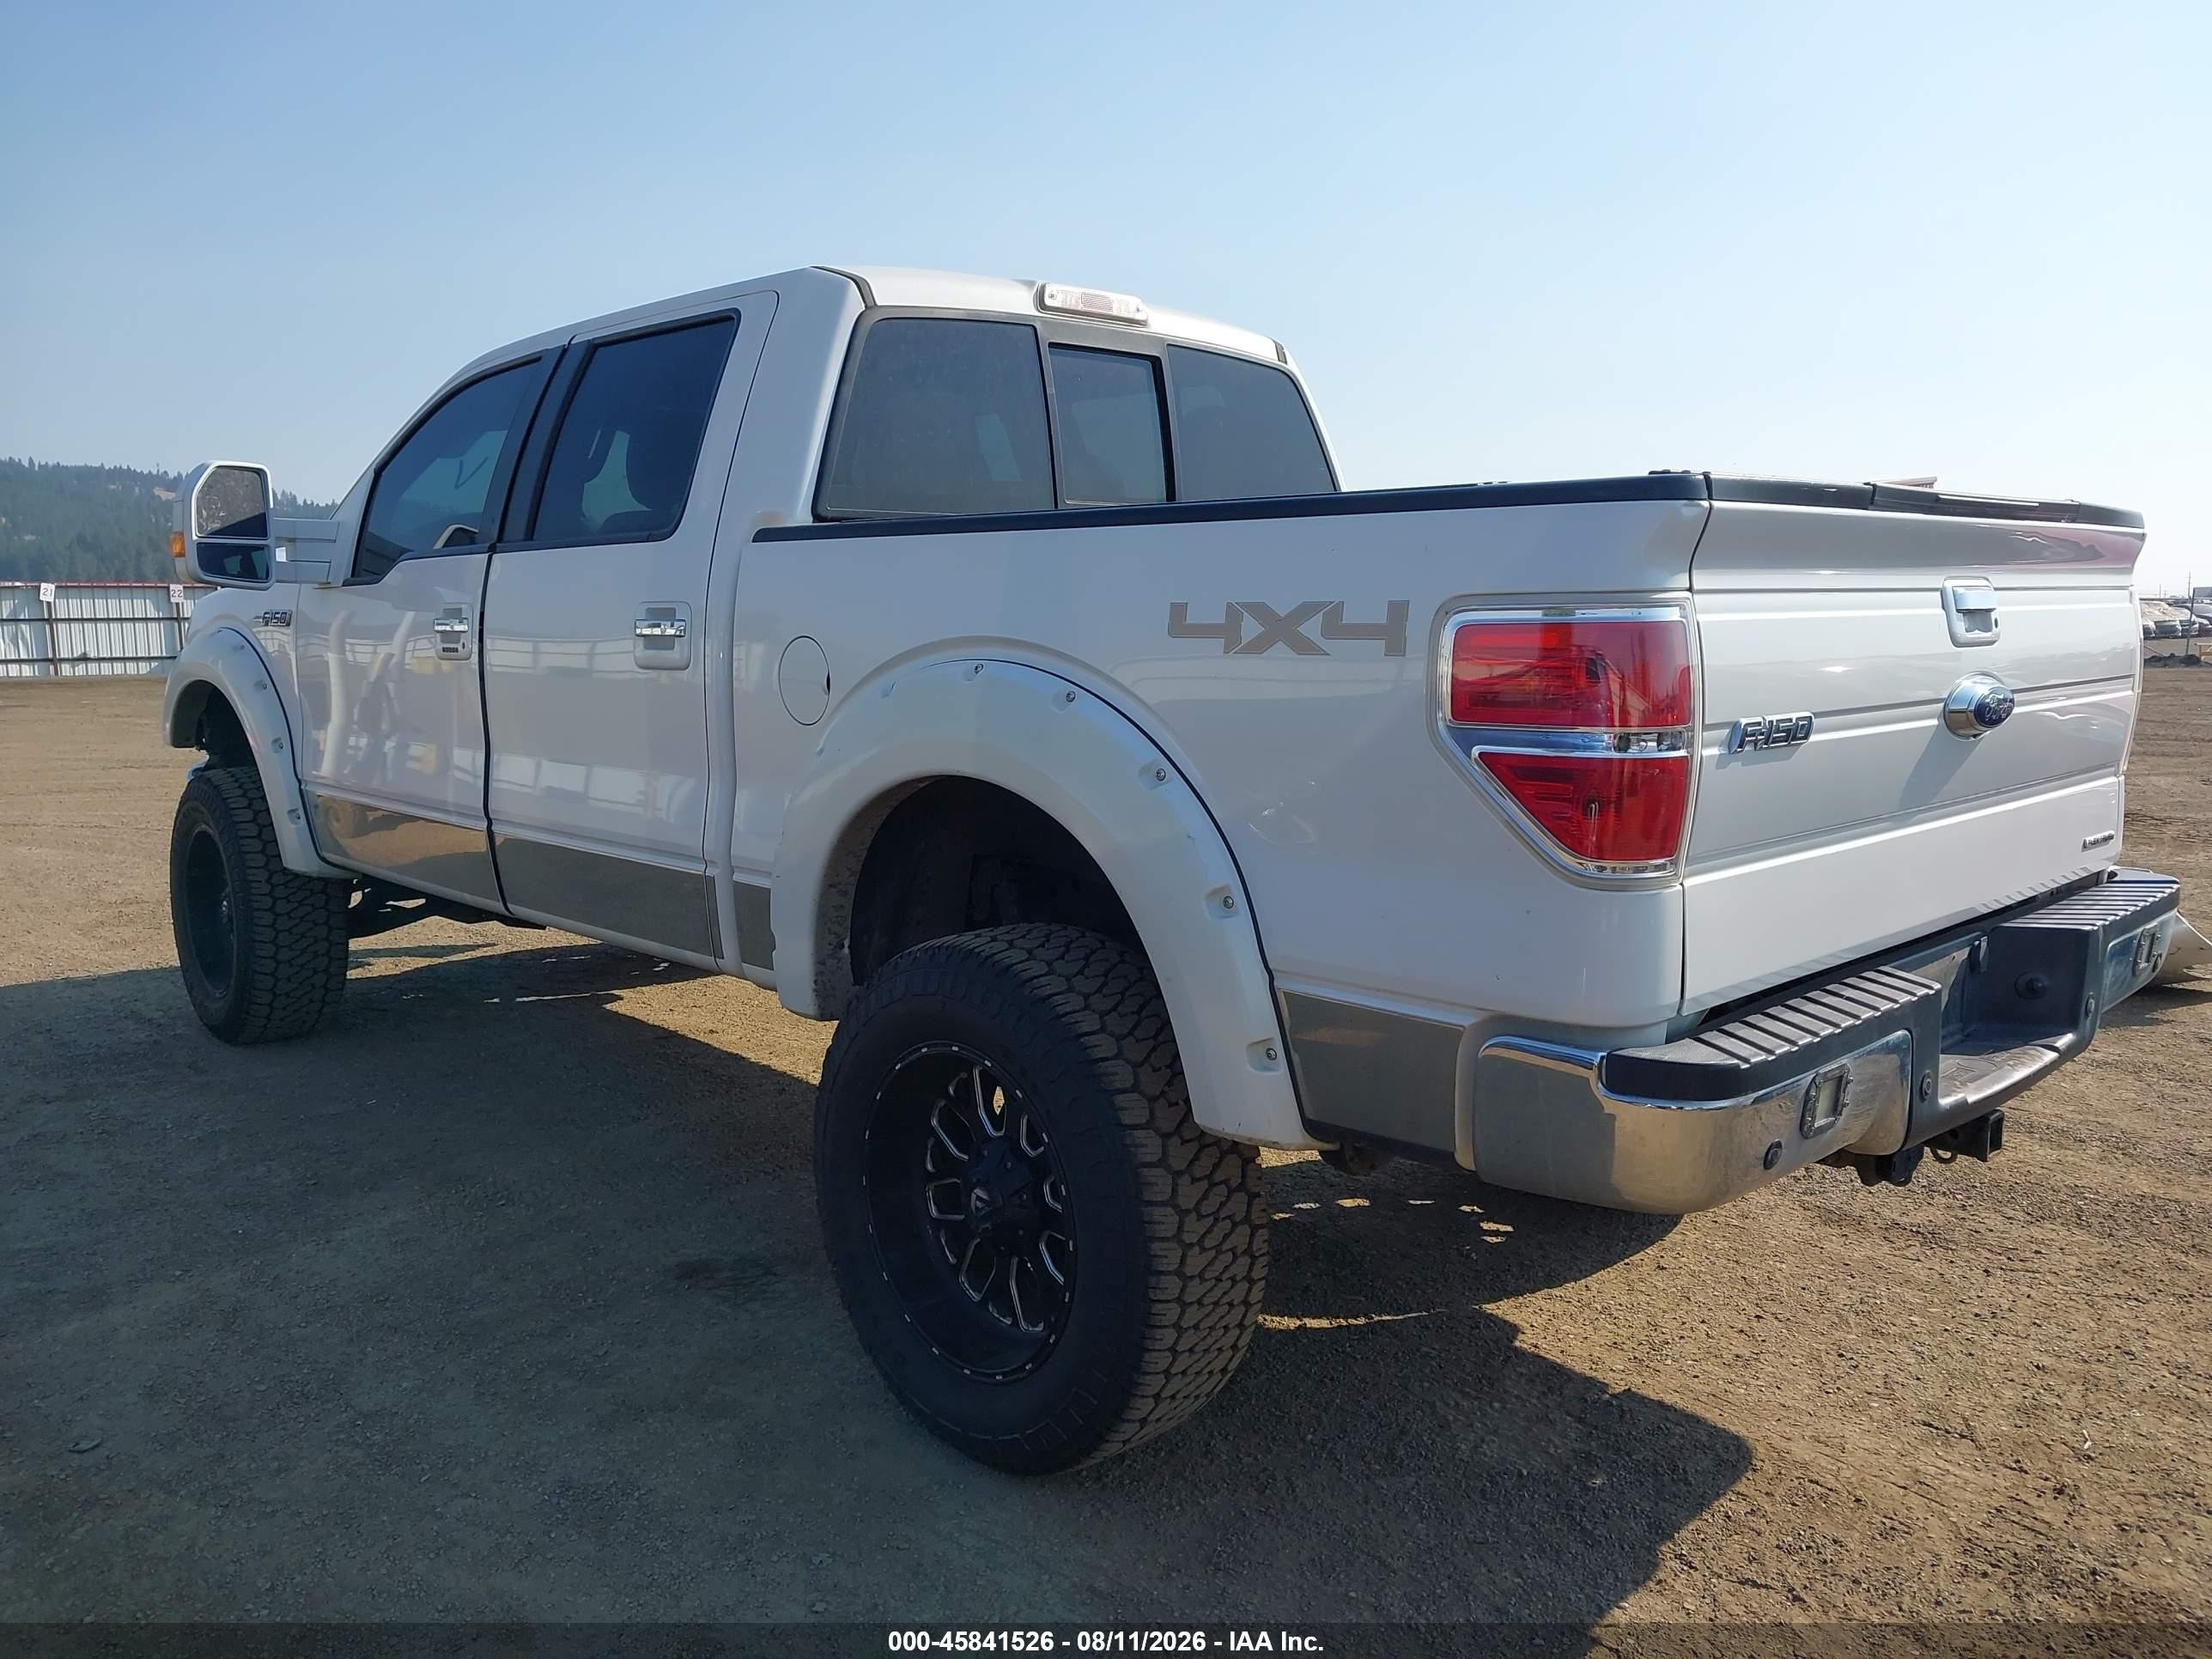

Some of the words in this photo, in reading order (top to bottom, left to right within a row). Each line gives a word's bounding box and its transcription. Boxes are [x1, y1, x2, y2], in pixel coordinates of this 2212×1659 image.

[43, 587, 53, 598] 21
[171, 588, 183, 598] 22
[1168, 600, 1409, 657] 4X4
